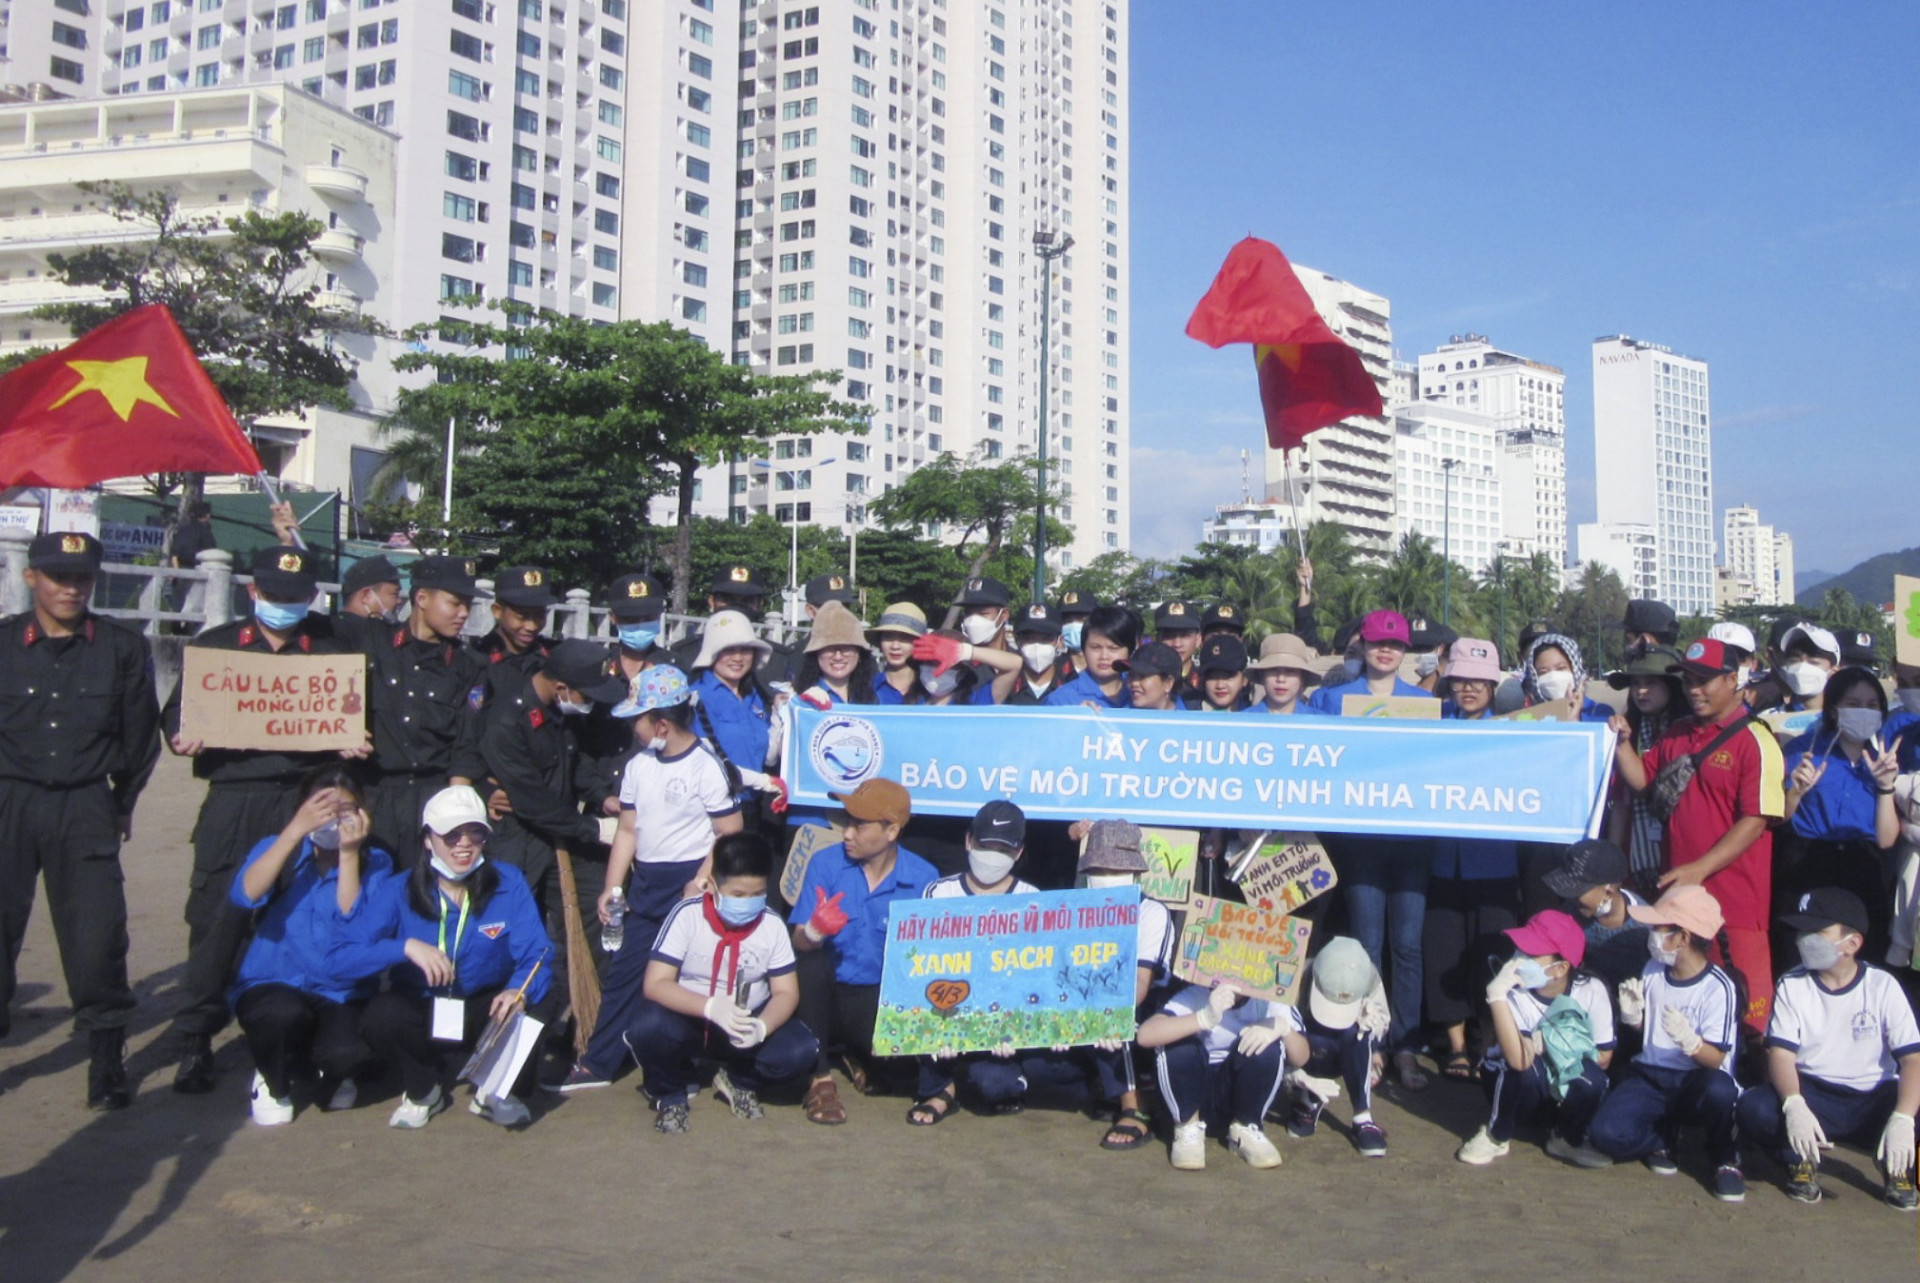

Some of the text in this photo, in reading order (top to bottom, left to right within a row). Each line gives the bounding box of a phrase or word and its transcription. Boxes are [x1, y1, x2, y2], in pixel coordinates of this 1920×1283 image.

[1600, 352, 1640, 365] NAVADA
[202, 667, 251, 692] CÂU
[258, 675, 299, 698] LẠC
[1081, 732, 1346, 768] HÃY CHUNG TAY
[902, 758, 967, 790] BẢO
[977, 766, 1018, 797] VỆ
[1031, 765, 1088, 796] MÔI
[1100, 771, 1242, 802] TRƯỜNG
[1255, 778, 1331, 810] VỊNH
[1344, 781, 1415, 809] NHA
[1424, 784, 1541, 814] TRANG
[1272, 853, 1288, 868] EM
[896, 913, 926, 941] HÃY
[976, 909, 1019, 941] ĐỘNG
[1042, 903, 1072, 931] MÔI
[908, 942, 1118, 977] XANH SẠCH ĐẸP
